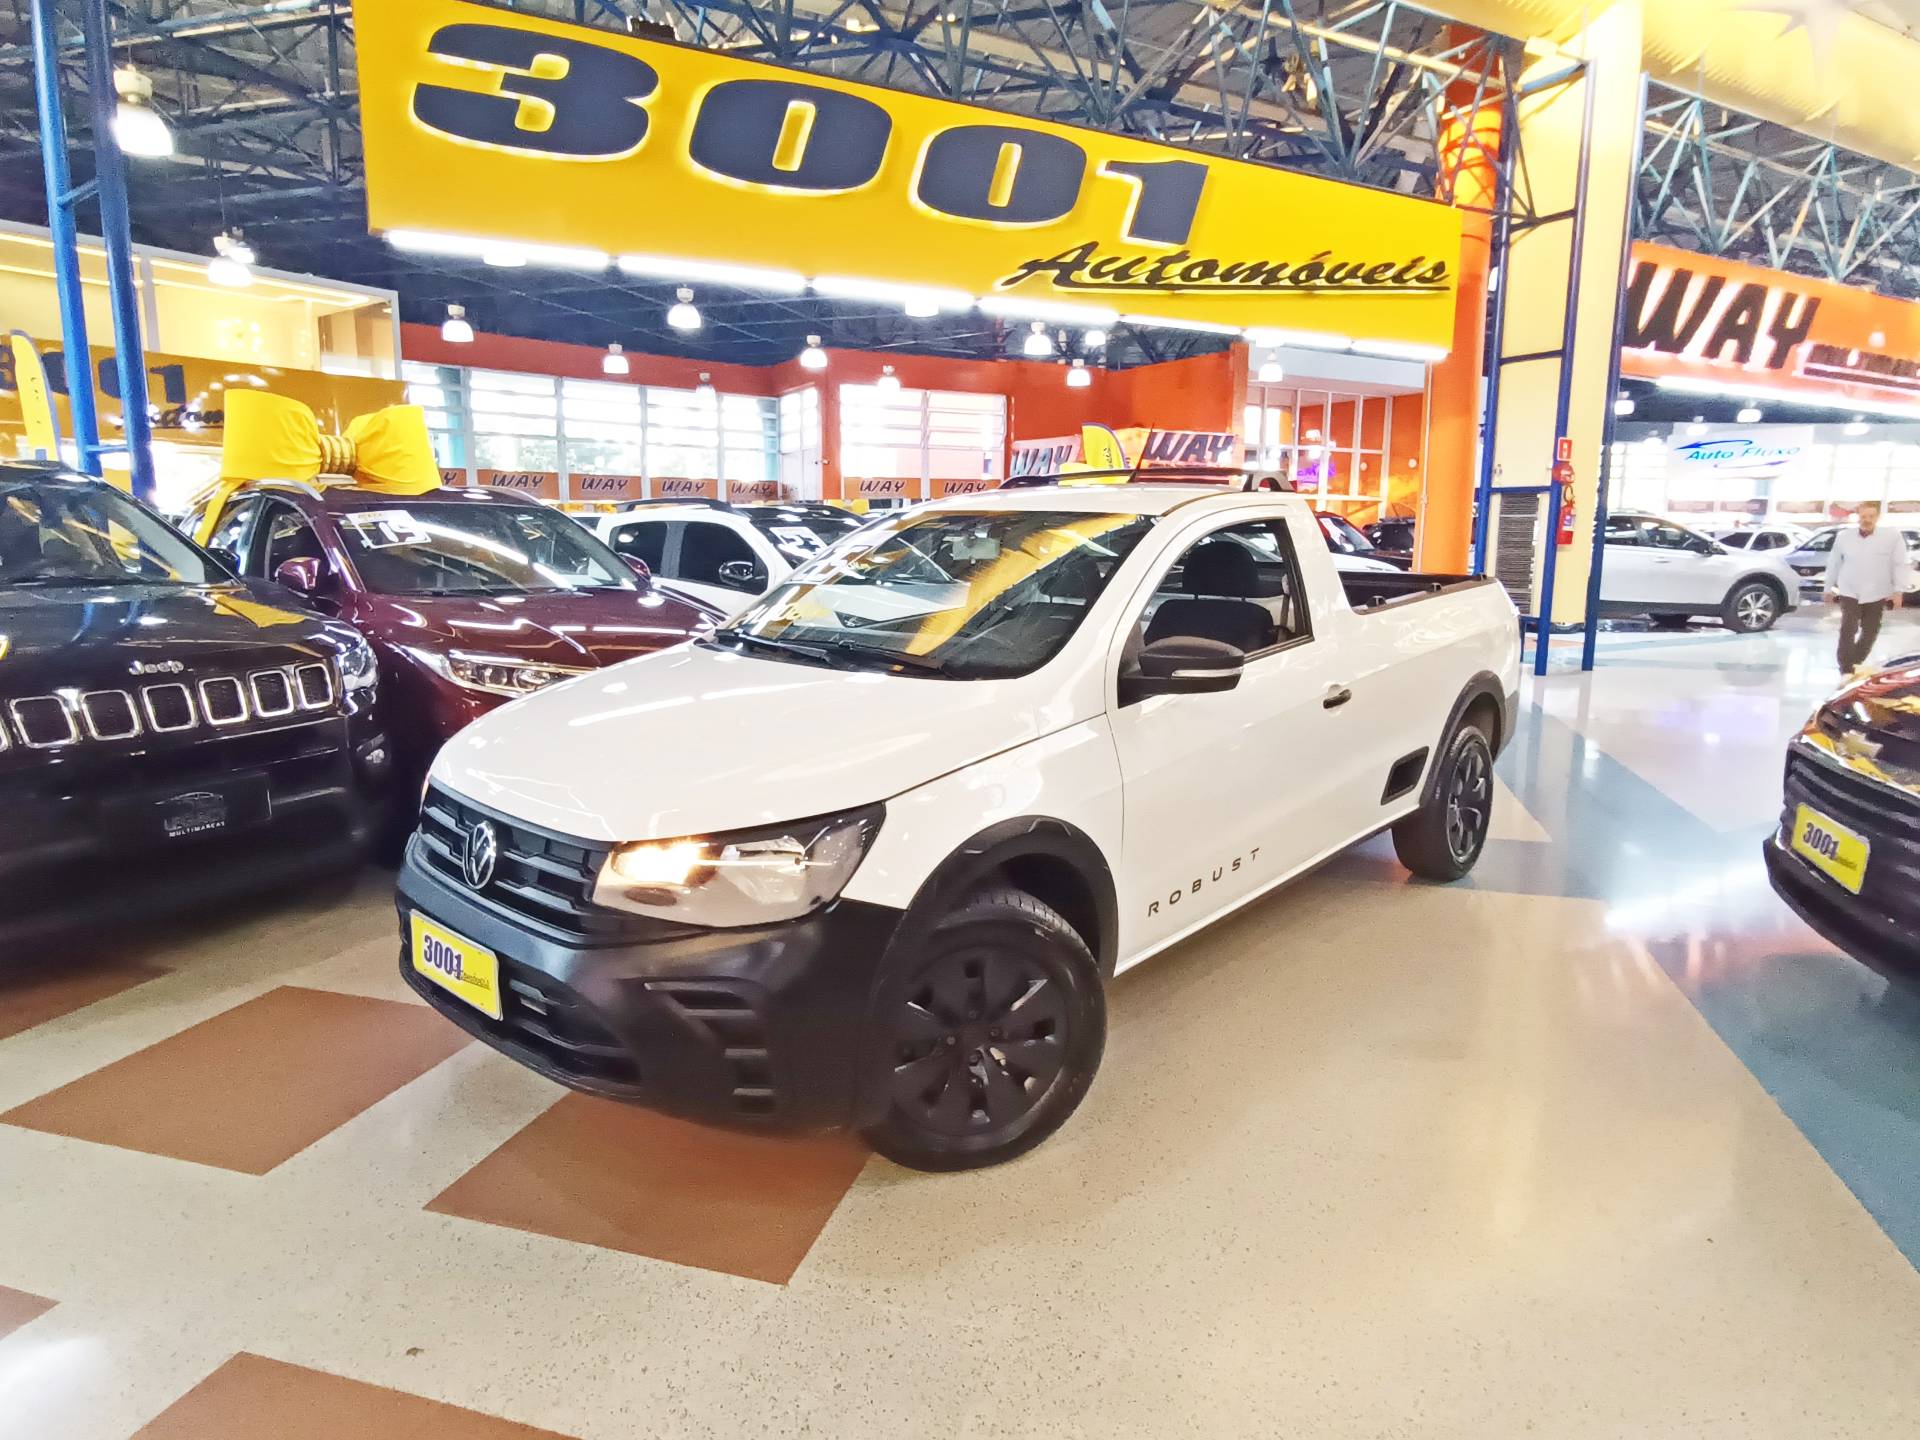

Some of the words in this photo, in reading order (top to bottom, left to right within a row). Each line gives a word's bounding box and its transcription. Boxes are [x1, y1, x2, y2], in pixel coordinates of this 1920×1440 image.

[414, 24, 1208, 245] 3001
[1000, 241, 1450, 290] Automóveis
[1622, 262, 1822, 370] WAY
[1011, 445, 1074, 479] WAY
[1145, 432, 1236, 463] WAY
[1684, 450, 1734, 461] Auto
[492, 474, 544, 488] WAY
[582, 478, 629, 491] WAY
[662, 480, 705, 493] WAY
[860, 480, 905, 493] WAY
[944, 482, 987, 494] WAY
[129, 660, 185, 675] Jeep
[1802, 822, 1840, 860] 3001
[1148, 847, 1260, 918] ROBUST
[423, 934, 463, 981] 3001
